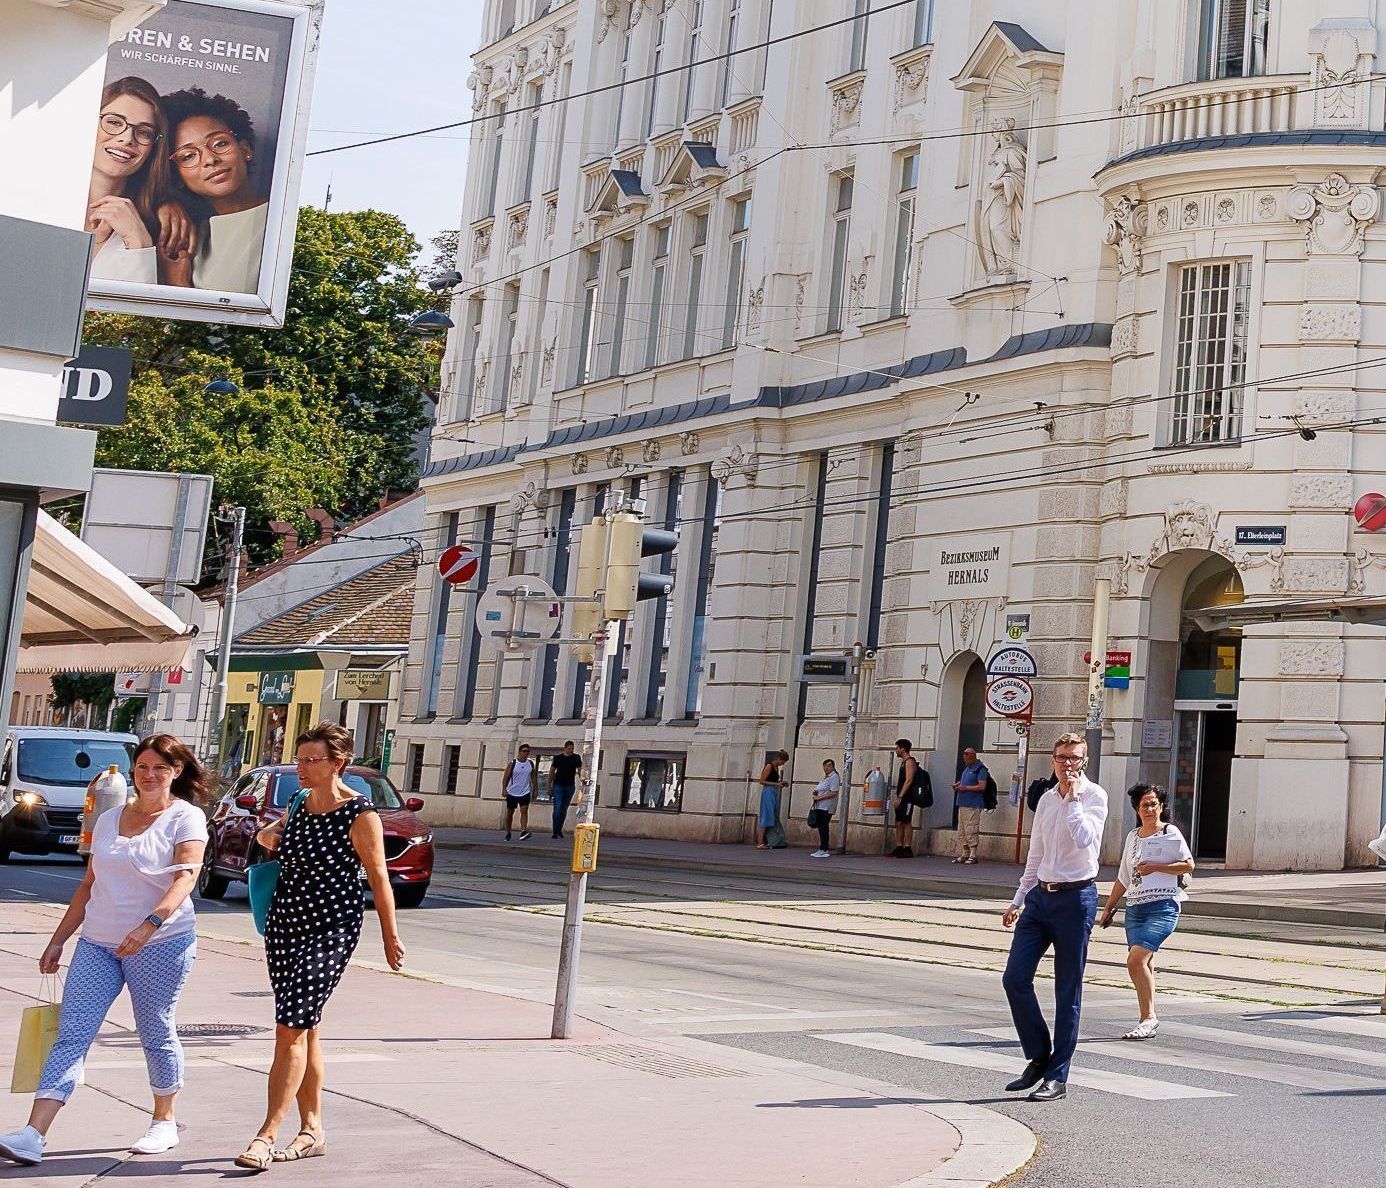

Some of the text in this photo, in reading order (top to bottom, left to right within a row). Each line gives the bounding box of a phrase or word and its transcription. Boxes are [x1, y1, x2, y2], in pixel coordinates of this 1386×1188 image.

[178, 35, 193, 52] &
[199, 38, 270, 62] SEHEN
[121, 49, 242, 75] WIR SCHÄRFEN SINNE.
[941, 547, 1000, 565] BEZIRKSMUSEUM
[948, 569, 989, 585] HERNALS
[1012, 628, 1019, 637] H
[1000, 651, 1027, 662] AUTOBUS
[992, 680, 1028, 694] STRASSENBAHN
[992, 699, 1026, 711] HALTESTELLE
